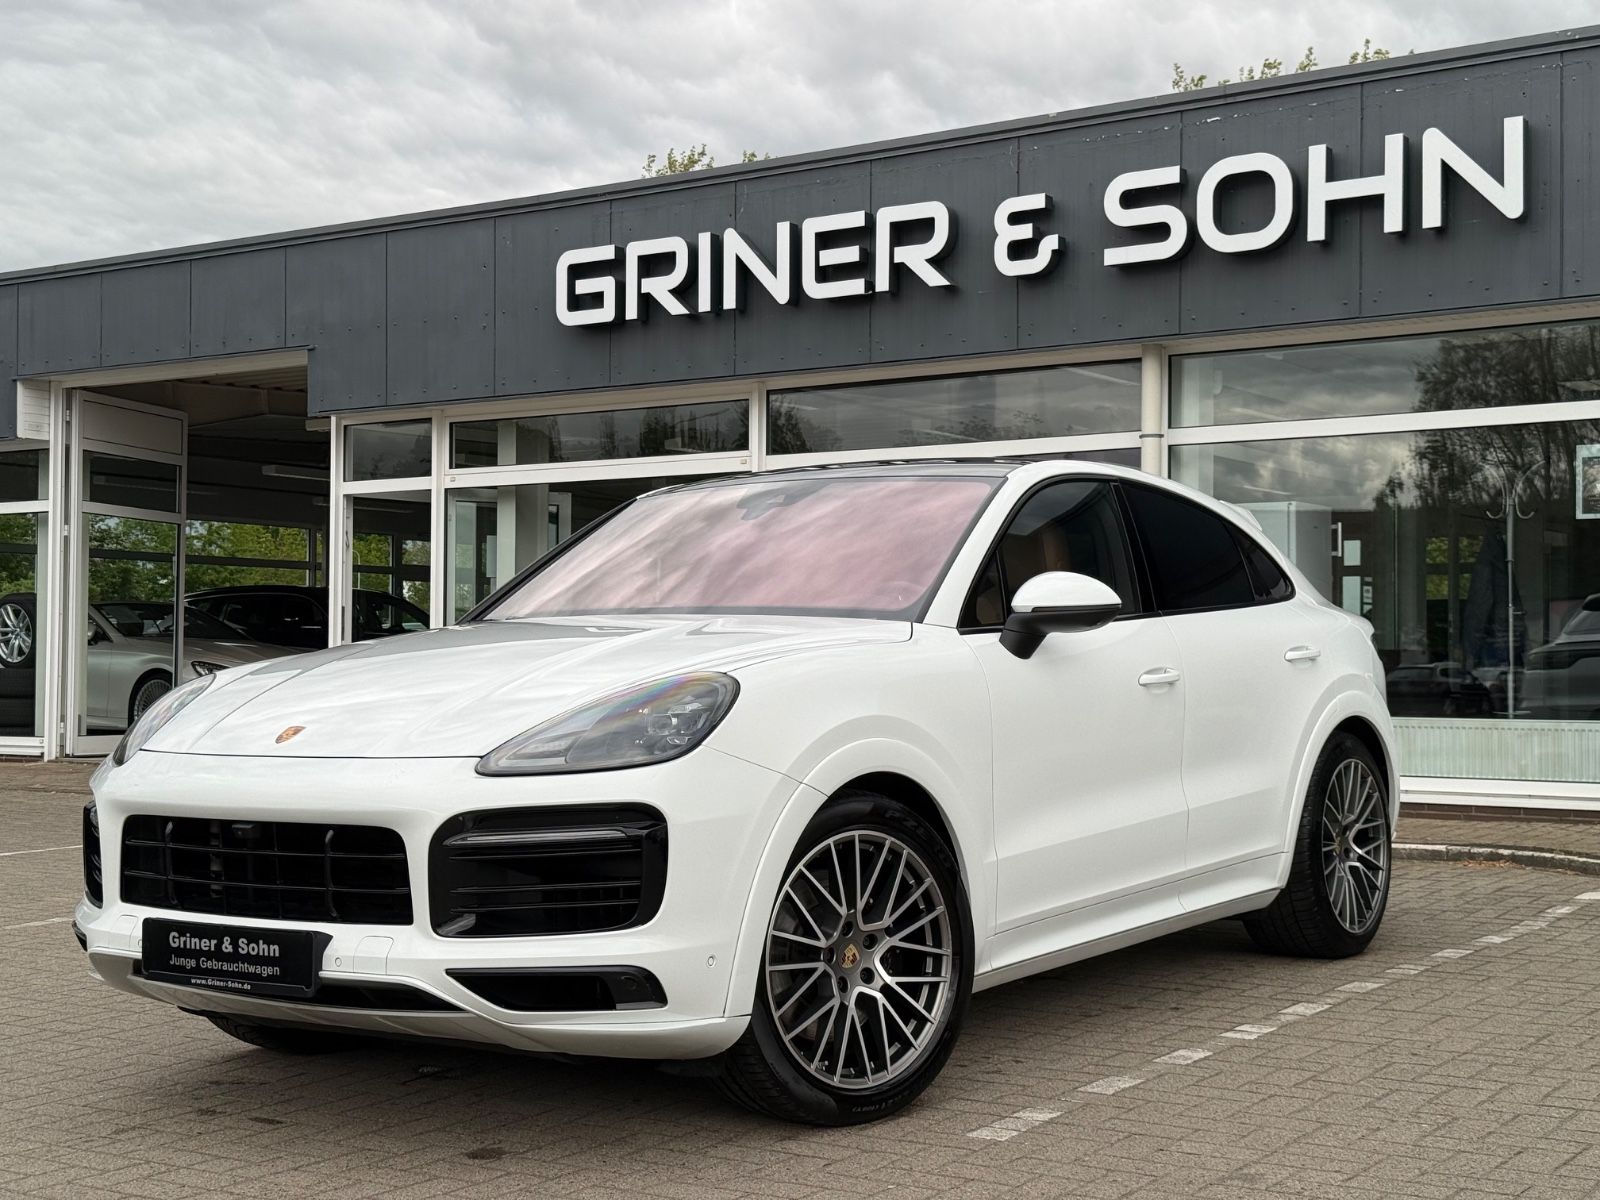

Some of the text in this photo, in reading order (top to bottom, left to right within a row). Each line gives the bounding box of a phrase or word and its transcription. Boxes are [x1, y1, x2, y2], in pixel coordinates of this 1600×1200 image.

[556, 115, 1525, 327] GRINER & SOHN
[168, 931, 280, 957] Griner & Sohn
[169, 954, 280, 977] Junge Gebrauchtwagen
[190, 977, 251, 990] www.Griner-Sohn.de
